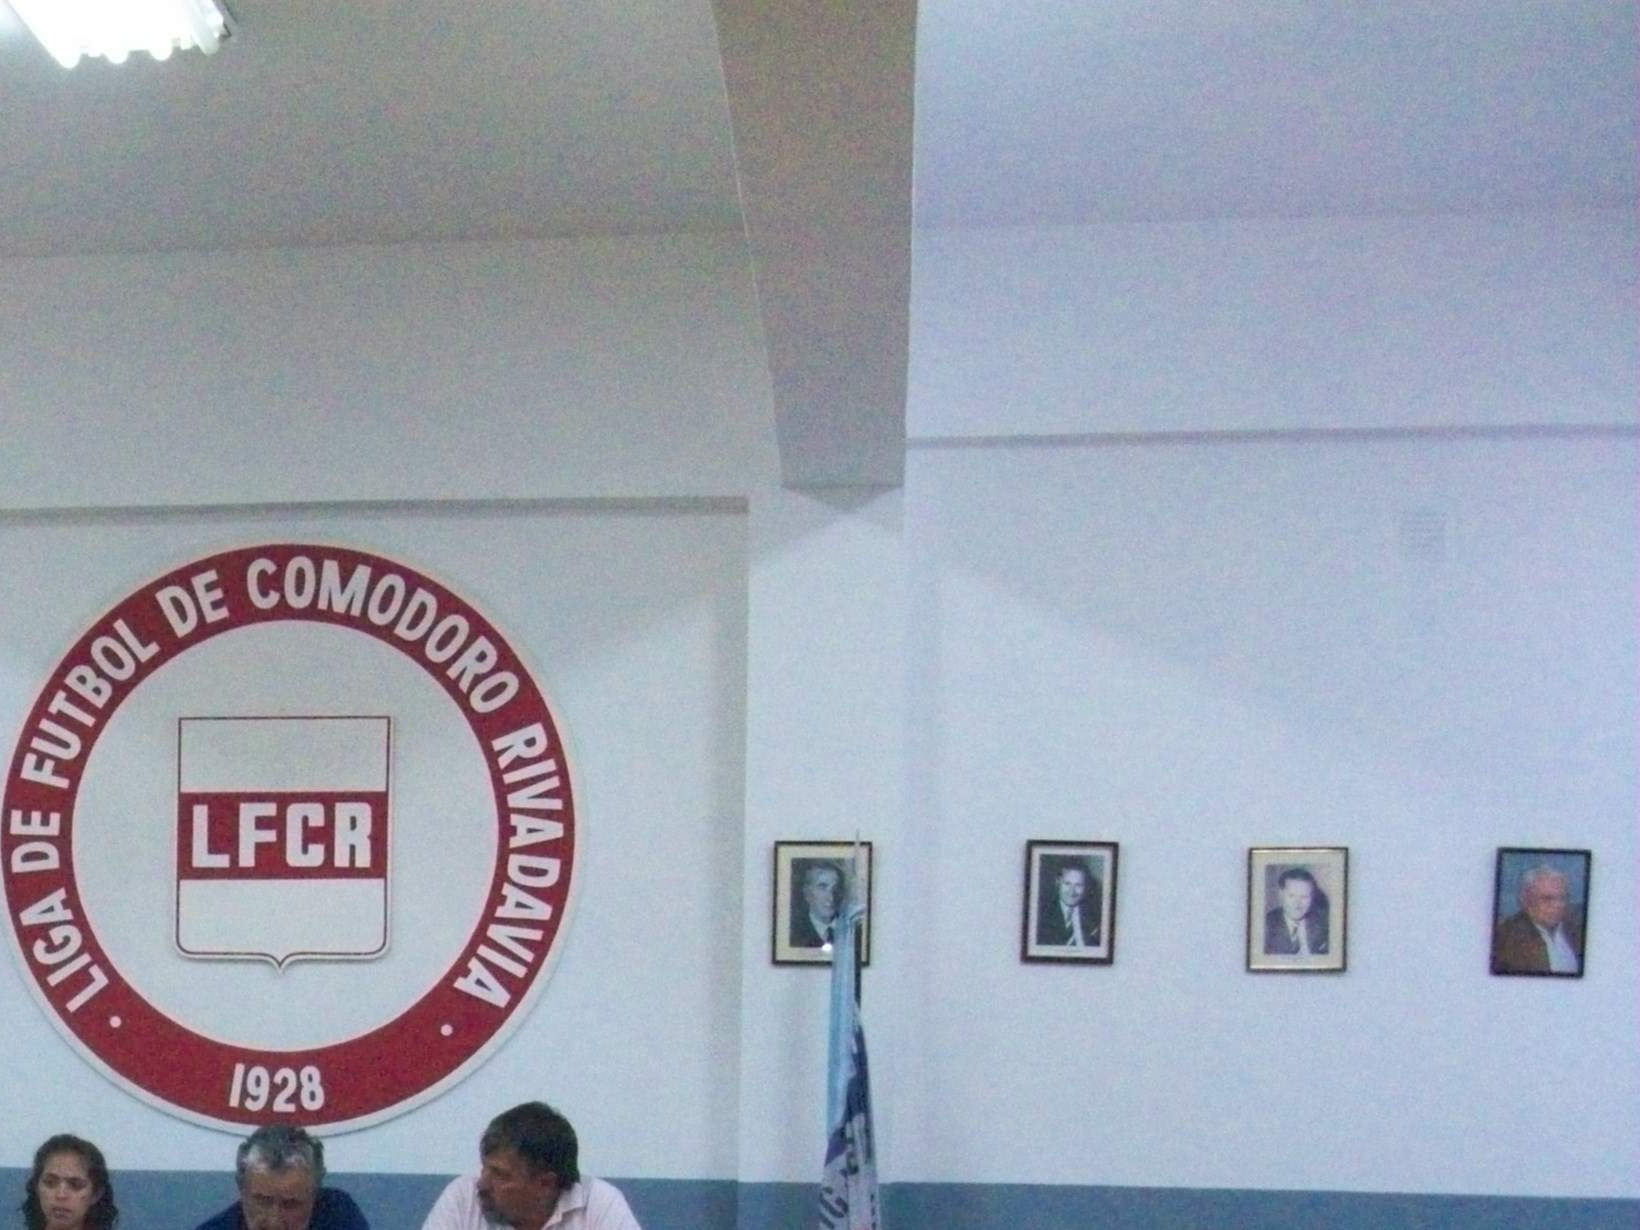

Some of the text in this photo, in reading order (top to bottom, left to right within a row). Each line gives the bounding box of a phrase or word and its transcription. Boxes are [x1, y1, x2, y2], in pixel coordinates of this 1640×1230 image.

[10, 555, 564, 1013] LIGA DE FUTBOL DE COMODORO RIVADAVIA
[191, 802, 372, 868] LFCR
[230, 1064, 325, 1112] 1928
